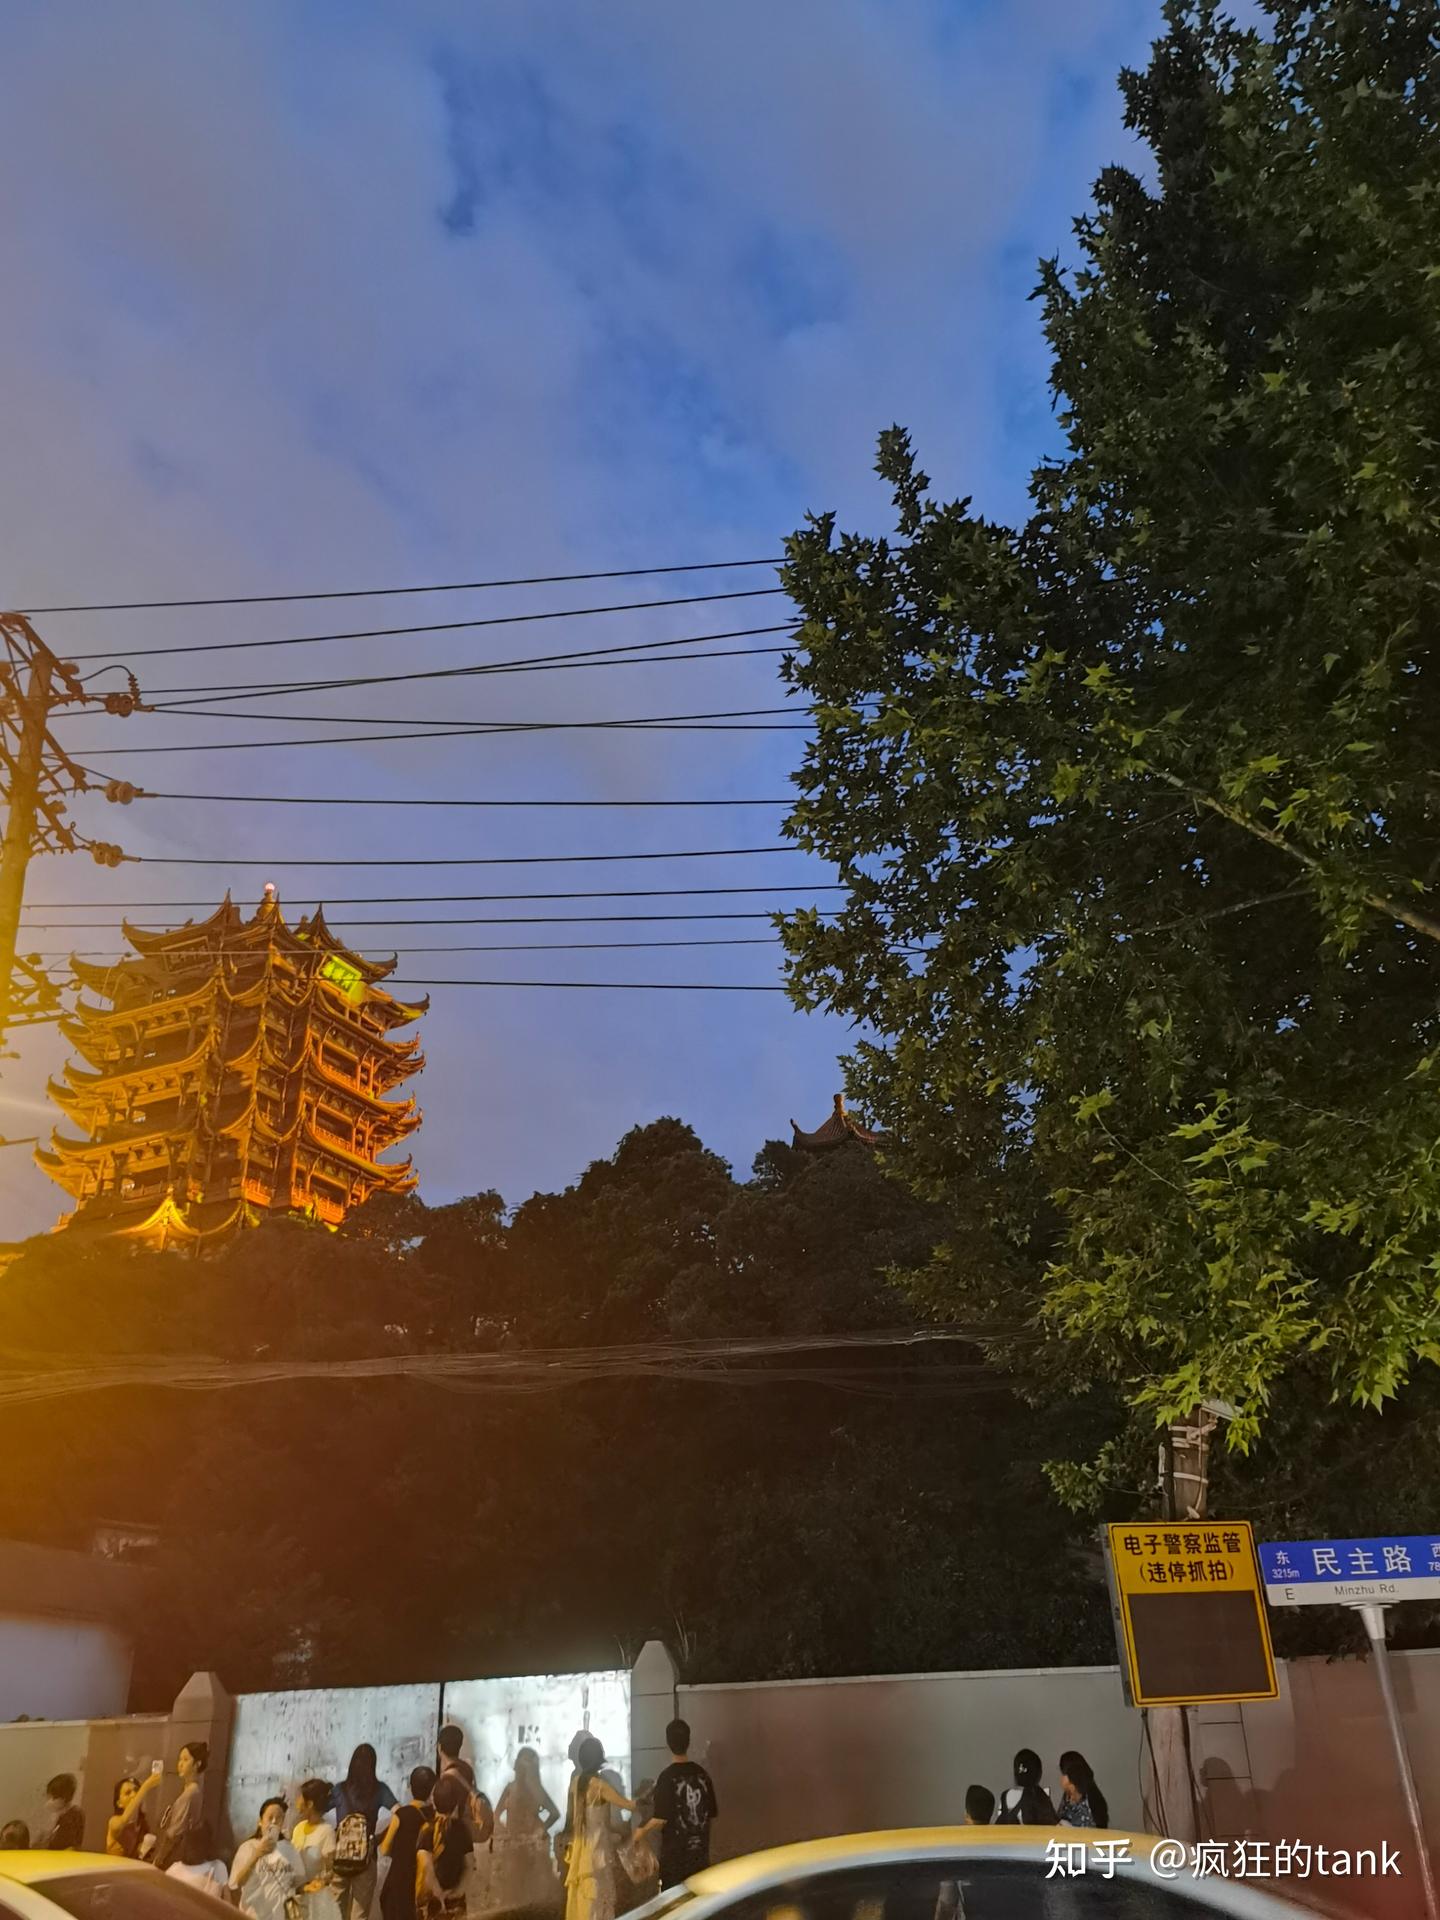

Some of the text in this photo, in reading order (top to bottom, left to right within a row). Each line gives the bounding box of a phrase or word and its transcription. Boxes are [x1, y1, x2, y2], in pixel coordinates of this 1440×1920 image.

[1124, 1532, 1241, 1556] 电子警察监管
[1275, 1550, 1291, 1566] 东
[1312, 1545, 1412, 1576] 民主路
[1272, 1567, 1300, 1579] 3215m
[1285, 1588, 1295, 1600] E
[1334, 1583, 1400, 1596] Minzhu Rd.
